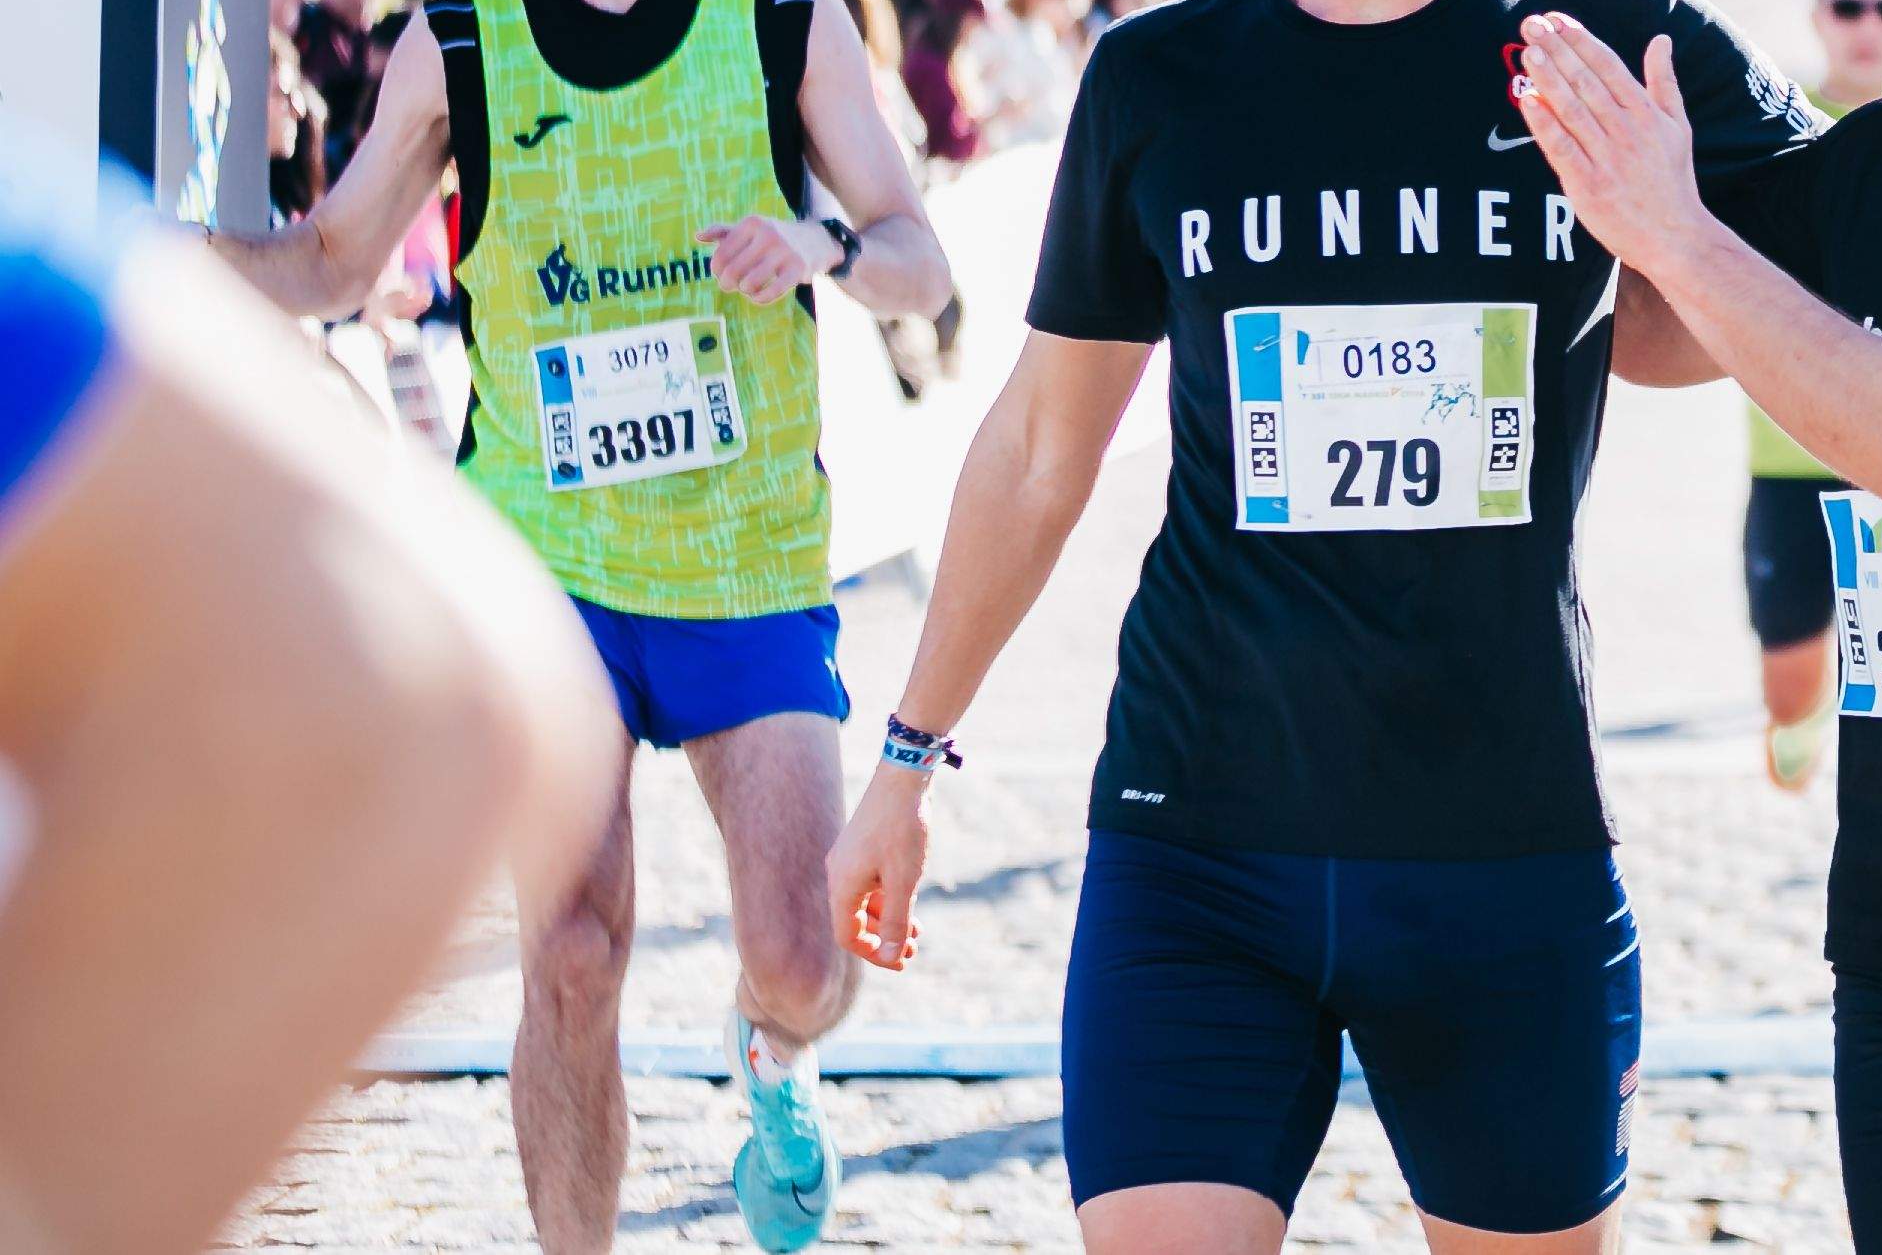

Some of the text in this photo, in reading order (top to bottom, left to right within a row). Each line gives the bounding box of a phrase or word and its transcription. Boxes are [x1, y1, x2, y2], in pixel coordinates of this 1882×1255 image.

[1180, 186, 1576, 278] RUNNER
[597, 249, 712, 298] Runni
[608, 339, 669, 373] 3079
[1343, 339, 1436, 379] 0183
[588, 409, 695, 468] 3397
[1326, 438, 1441, 507] 279
